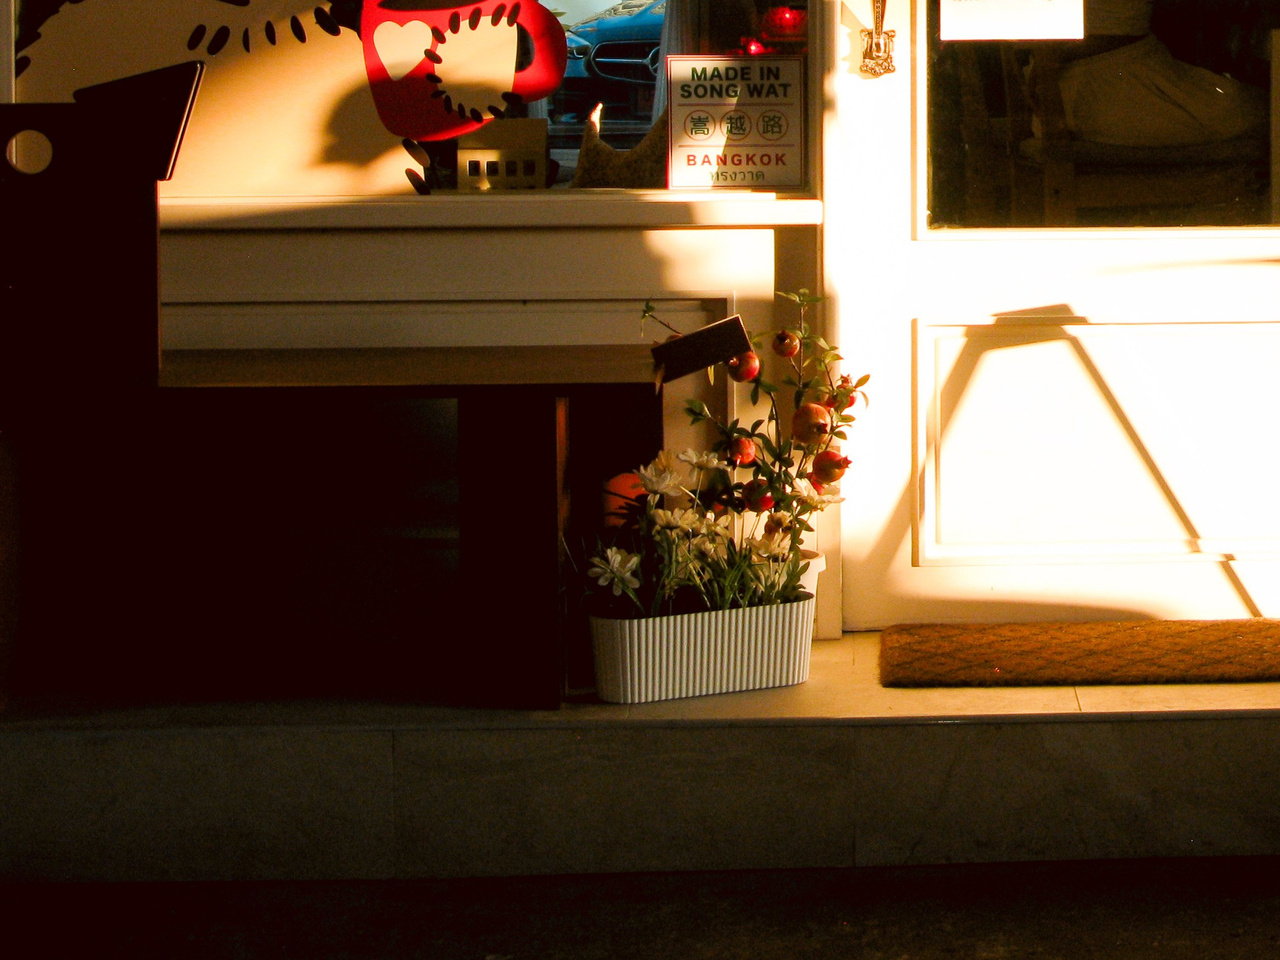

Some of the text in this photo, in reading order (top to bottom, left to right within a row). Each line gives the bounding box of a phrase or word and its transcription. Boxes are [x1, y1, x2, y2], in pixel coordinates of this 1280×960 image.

[691, 66, 780, 81] MADE IN
[680, 83, 791, 99] SONG WAT
[686, 153, 787, 166] BANGKOK
[709, 170, 765, 182] ทรงวาด
